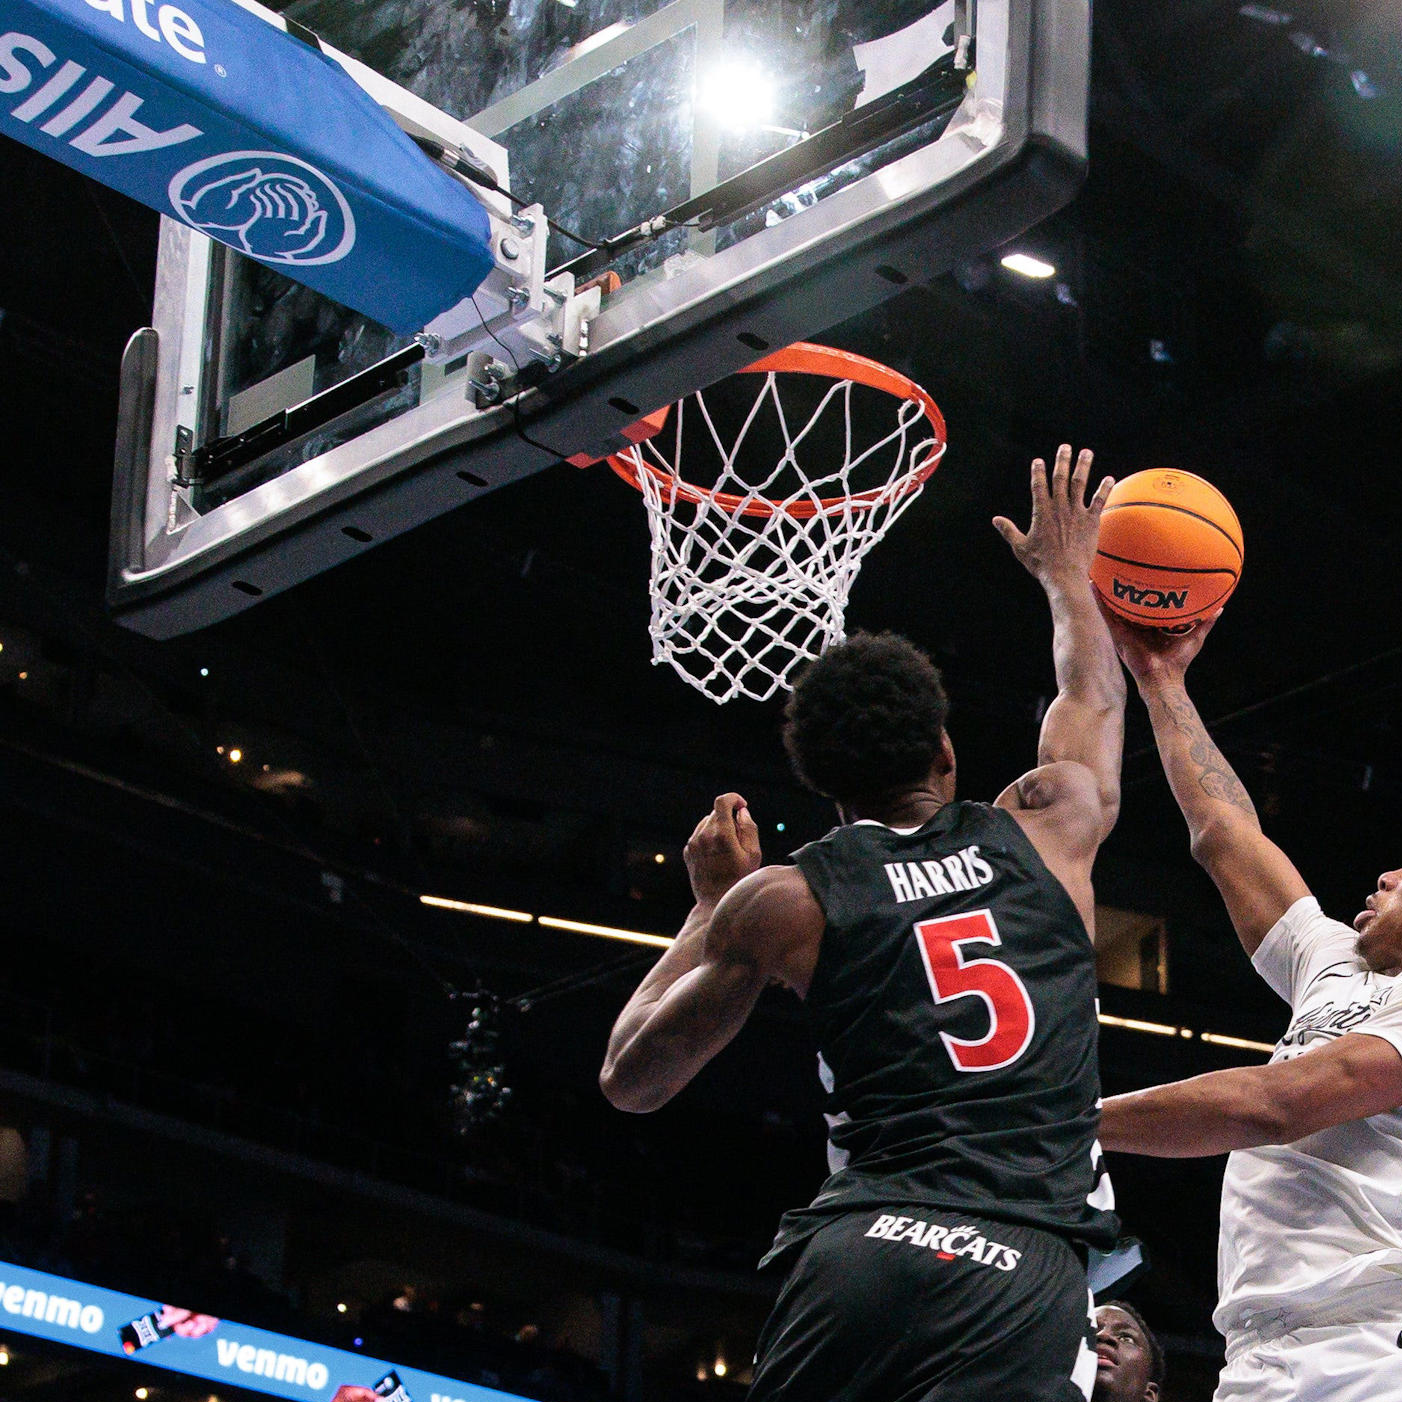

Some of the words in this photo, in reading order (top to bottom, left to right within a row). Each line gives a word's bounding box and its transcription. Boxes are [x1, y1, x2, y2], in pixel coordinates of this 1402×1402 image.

[1112, 577, 1189, 609] NCAA
[884, 845, 994, 904] HARRIS
[913, 908, 1036, 1073] 5
[864, 1214, 1022, 1272] BEARCATS
[0, 1281, 104, 1334] enmo
[216, 1338, 329, 1390] venmo
